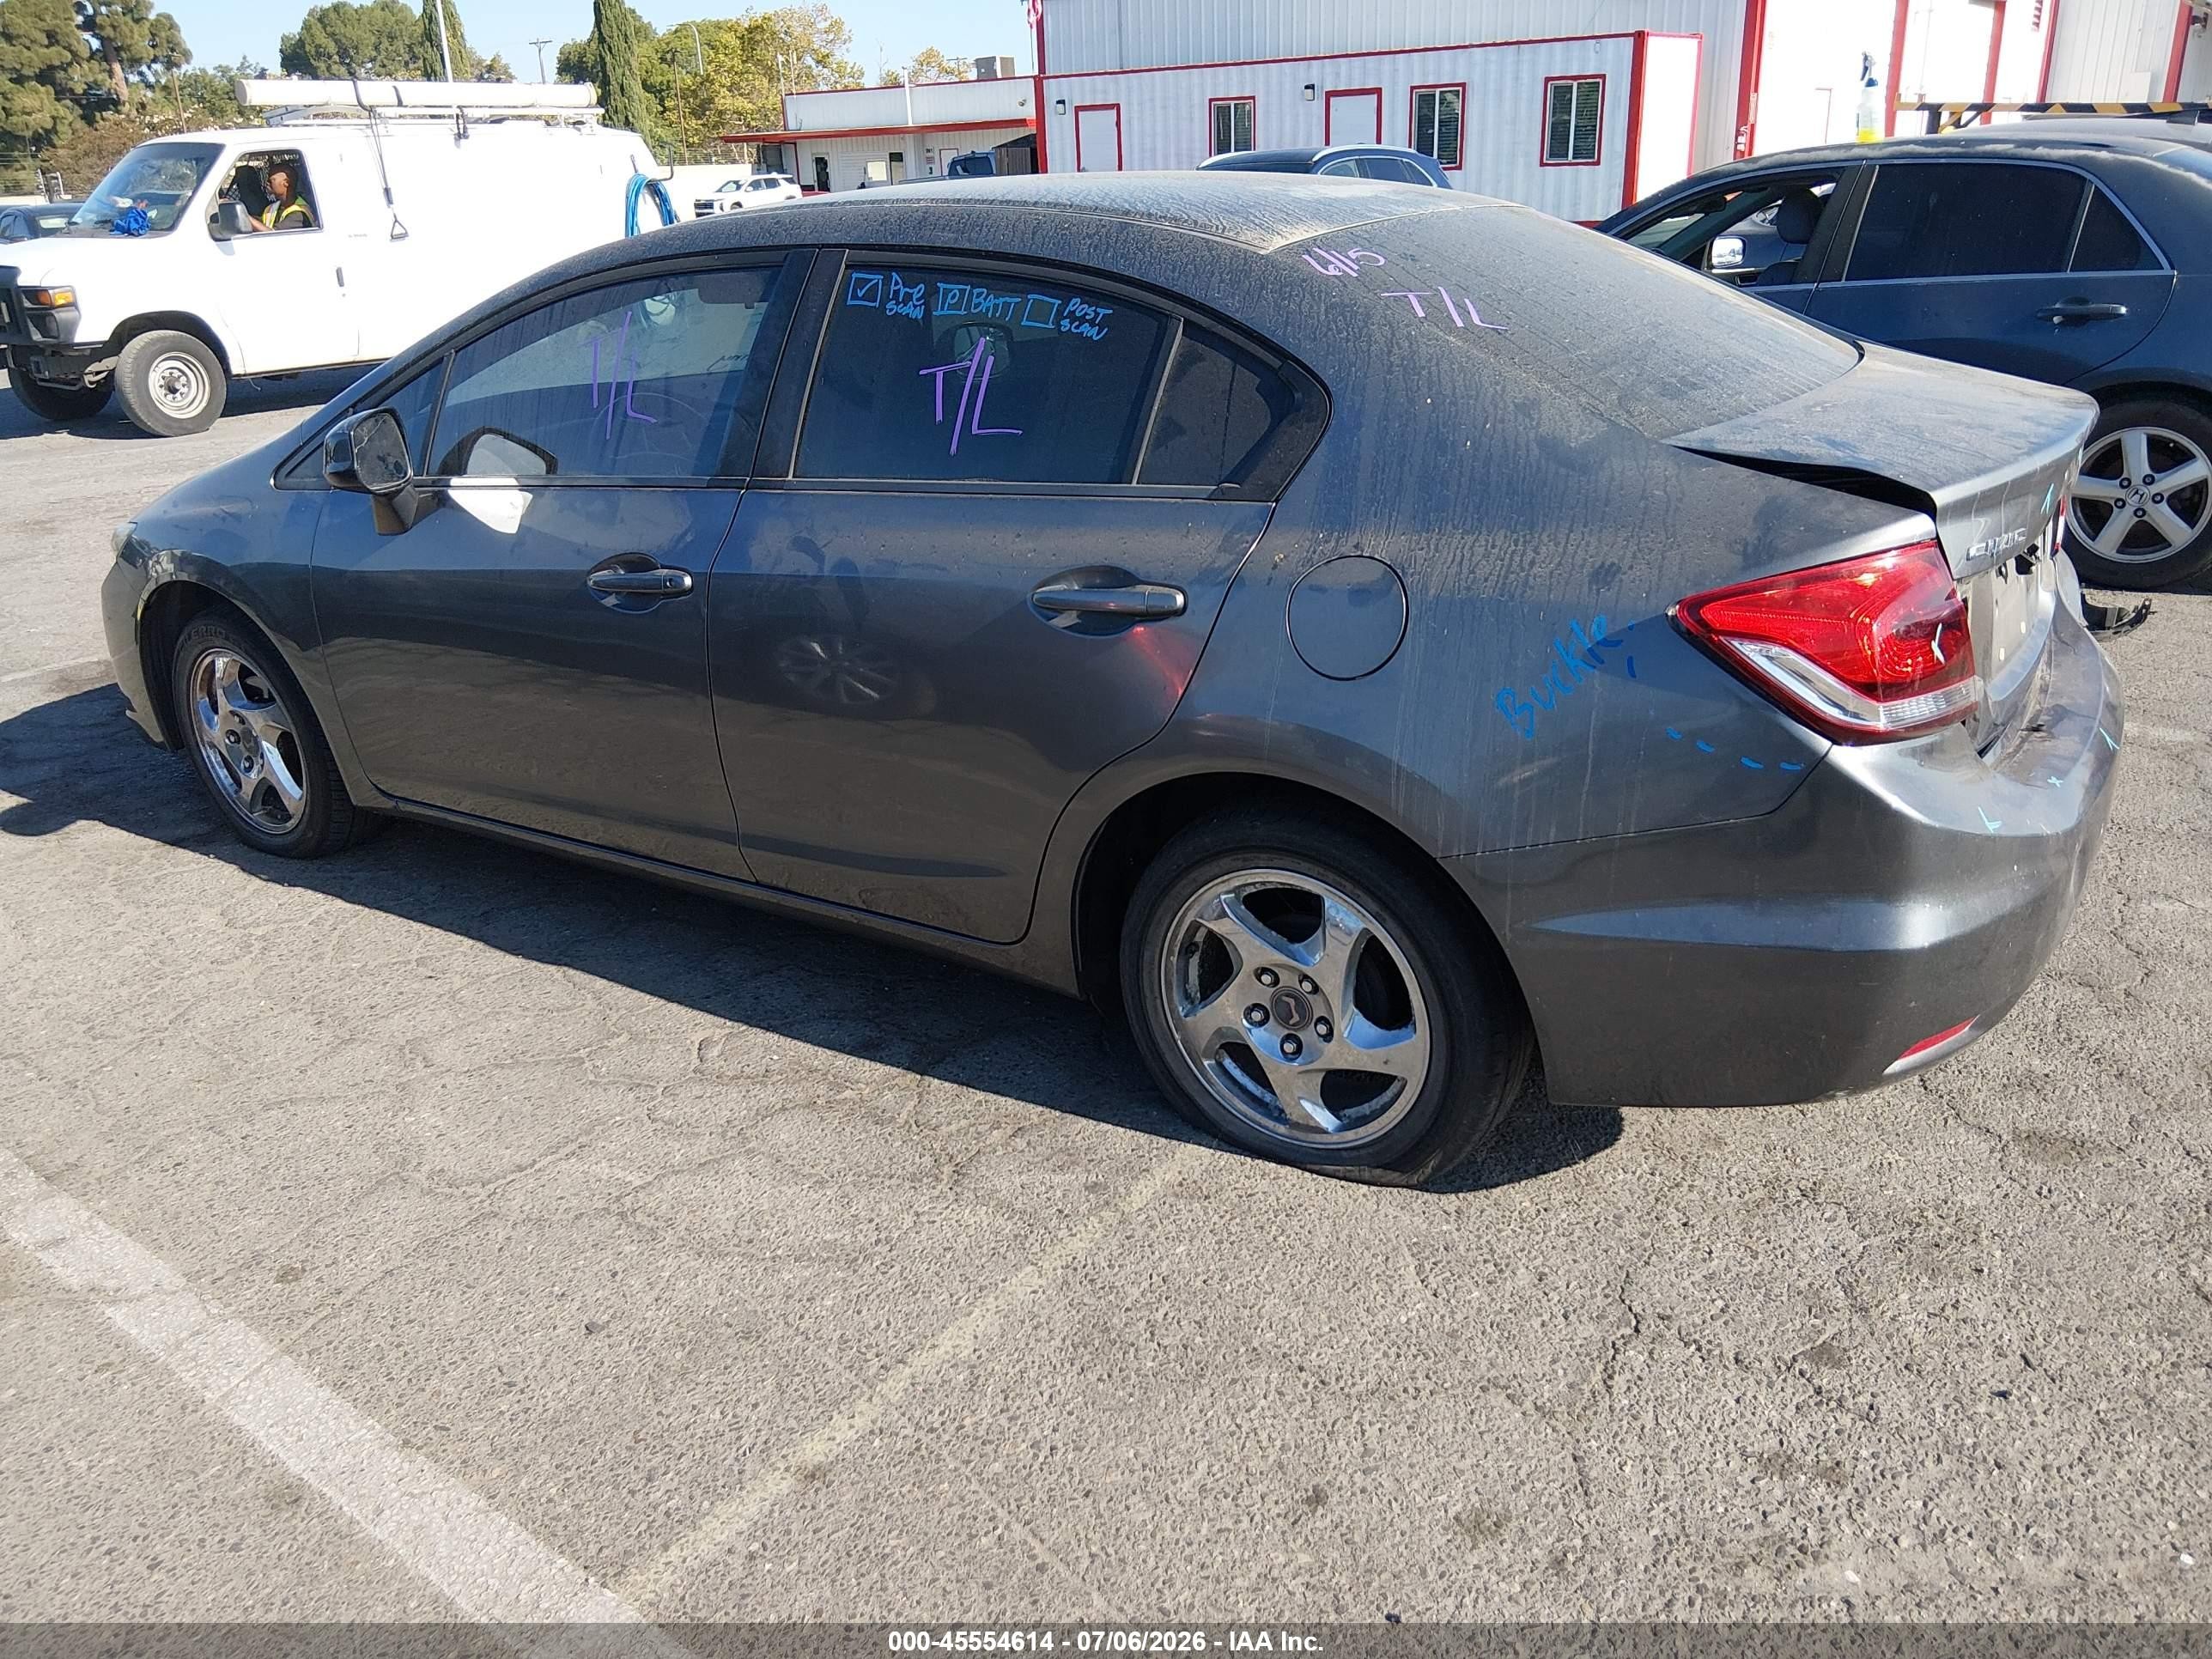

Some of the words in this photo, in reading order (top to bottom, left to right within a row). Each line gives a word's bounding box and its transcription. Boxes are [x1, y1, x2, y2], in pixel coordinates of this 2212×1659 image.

[890, 272, 926, 301] Pre
[970, 288, 1022, 322] BATT
[1380, 286, 1510, 331] T/L
[919, 337, 1024, 457] T/L
